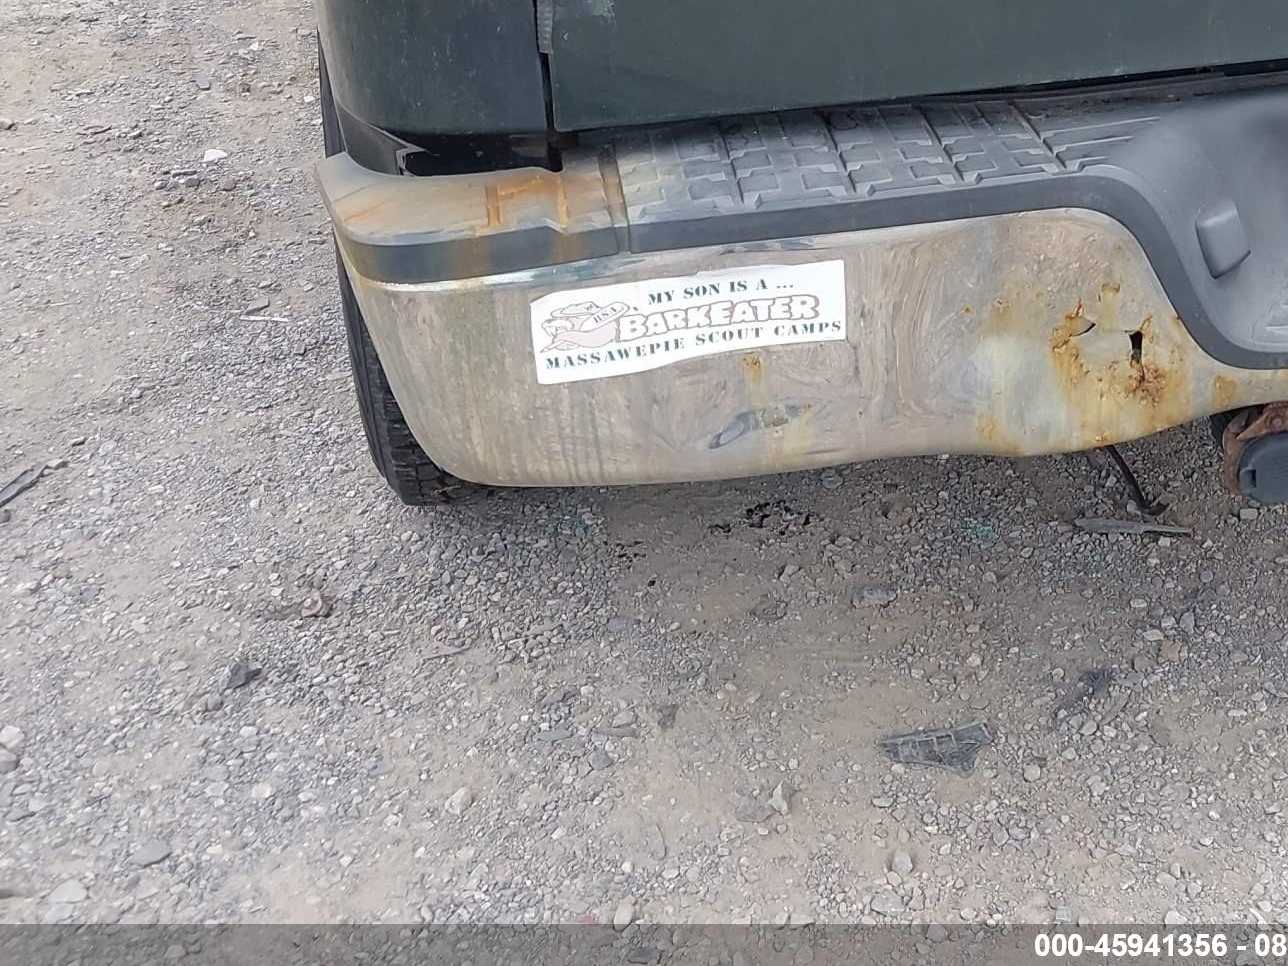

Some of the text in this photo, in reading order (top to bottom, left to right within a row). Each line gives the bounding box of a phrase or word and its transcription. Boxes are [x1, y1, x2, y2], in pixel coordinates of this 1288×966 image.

[647, 289, 676, 306] MY
[682, 283, 721, 300] SON
[729, 279, 748, 293] IS
[618, 294, 820, 343] BARKEATER
[545, 320, 842, 370] MASSAWEPIE SCOUT CAMPS
